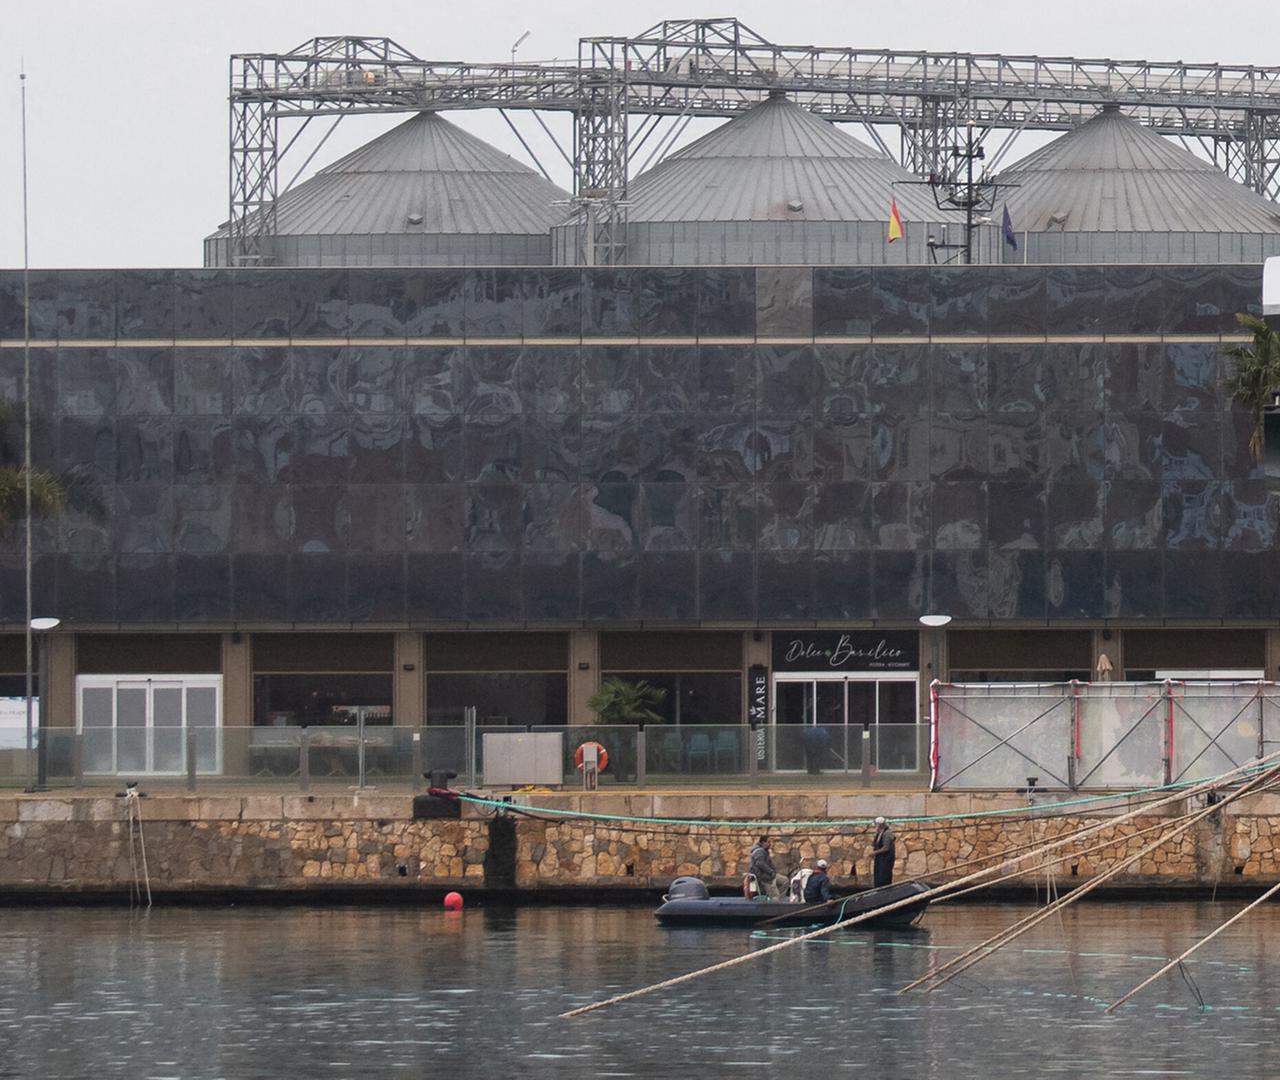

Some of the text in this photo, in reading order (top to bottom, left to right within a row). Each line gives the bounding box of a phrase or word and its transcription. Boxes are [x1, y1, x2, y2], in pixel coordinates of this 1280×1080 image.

[785, 634, 905, 667] Dolce Basilico
[756, 676, 766, 718] MARE
